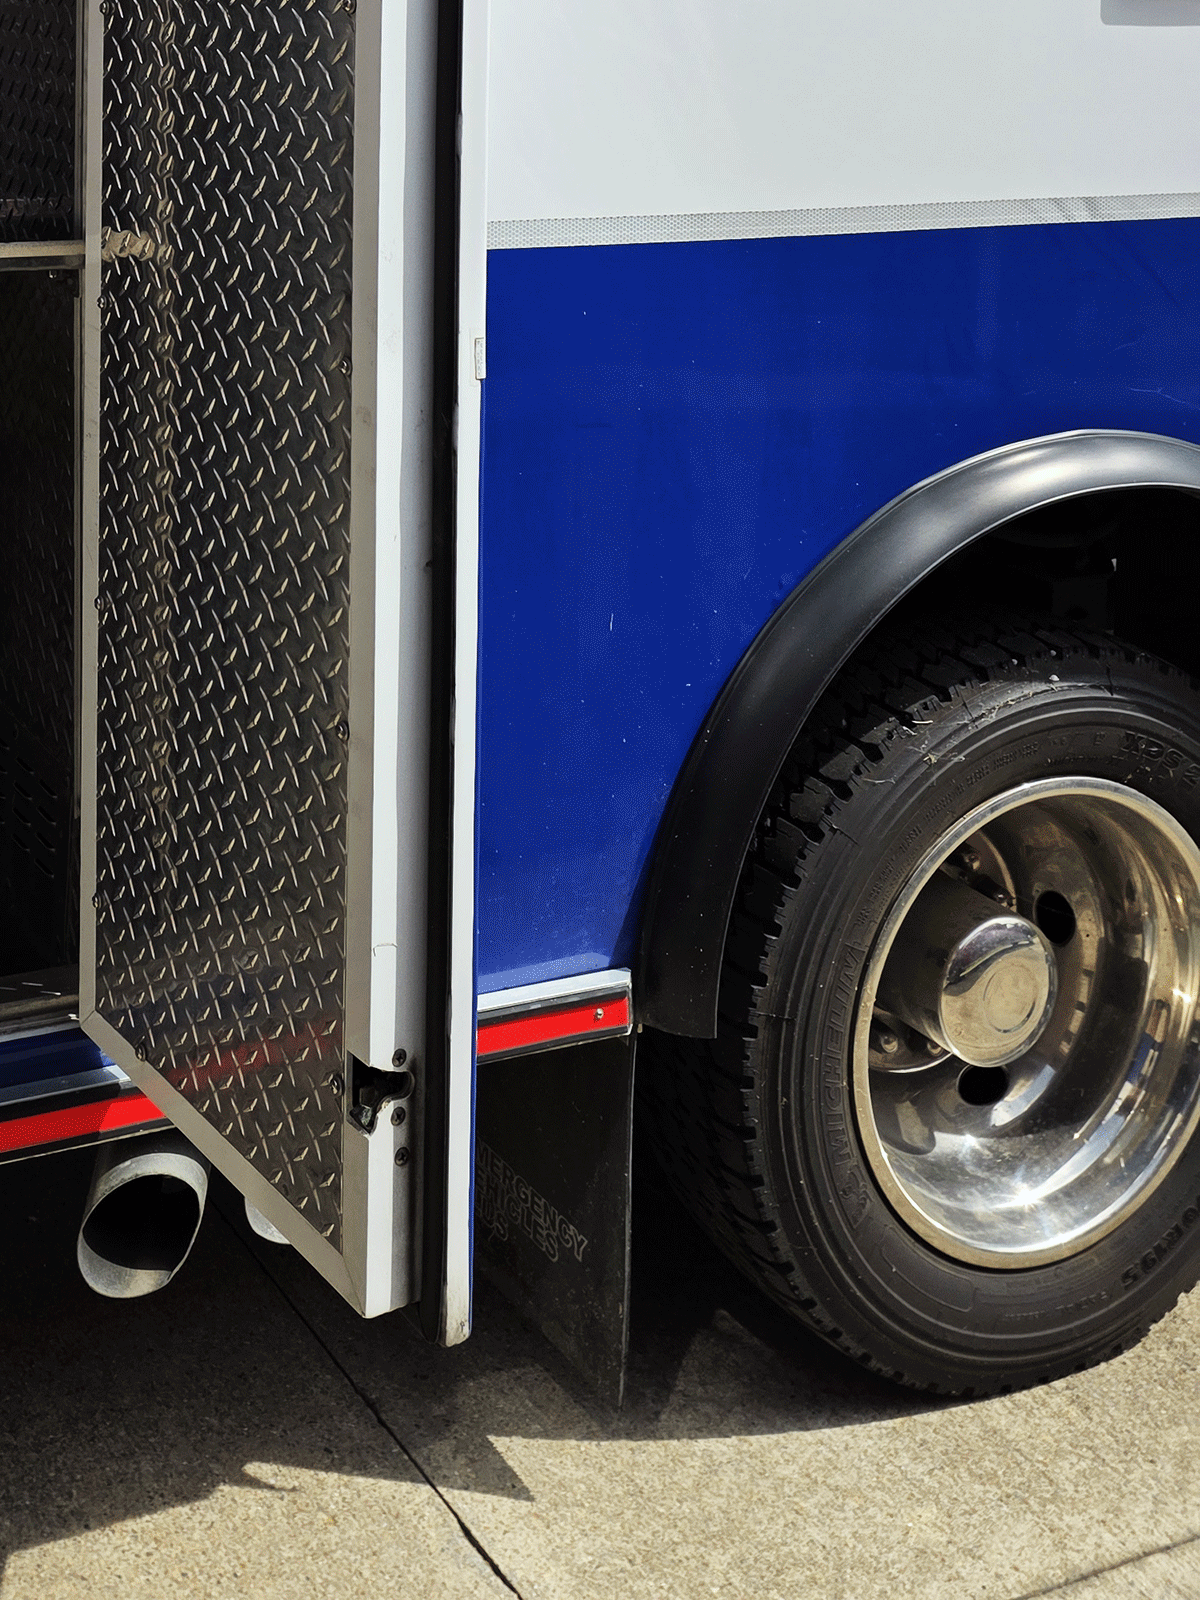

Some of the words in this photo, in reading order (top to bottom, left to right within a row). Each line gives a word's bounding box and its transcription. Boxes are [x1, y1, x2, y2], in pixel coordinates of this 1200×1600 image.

[825, 946, 859, 1166] MICHELIN
[476, 1137, 588, 1261] MERGENCY
[476, 1164, 559, 1262] EHICLES
[1122, 1200, 1200, 1291] 0R19.5
